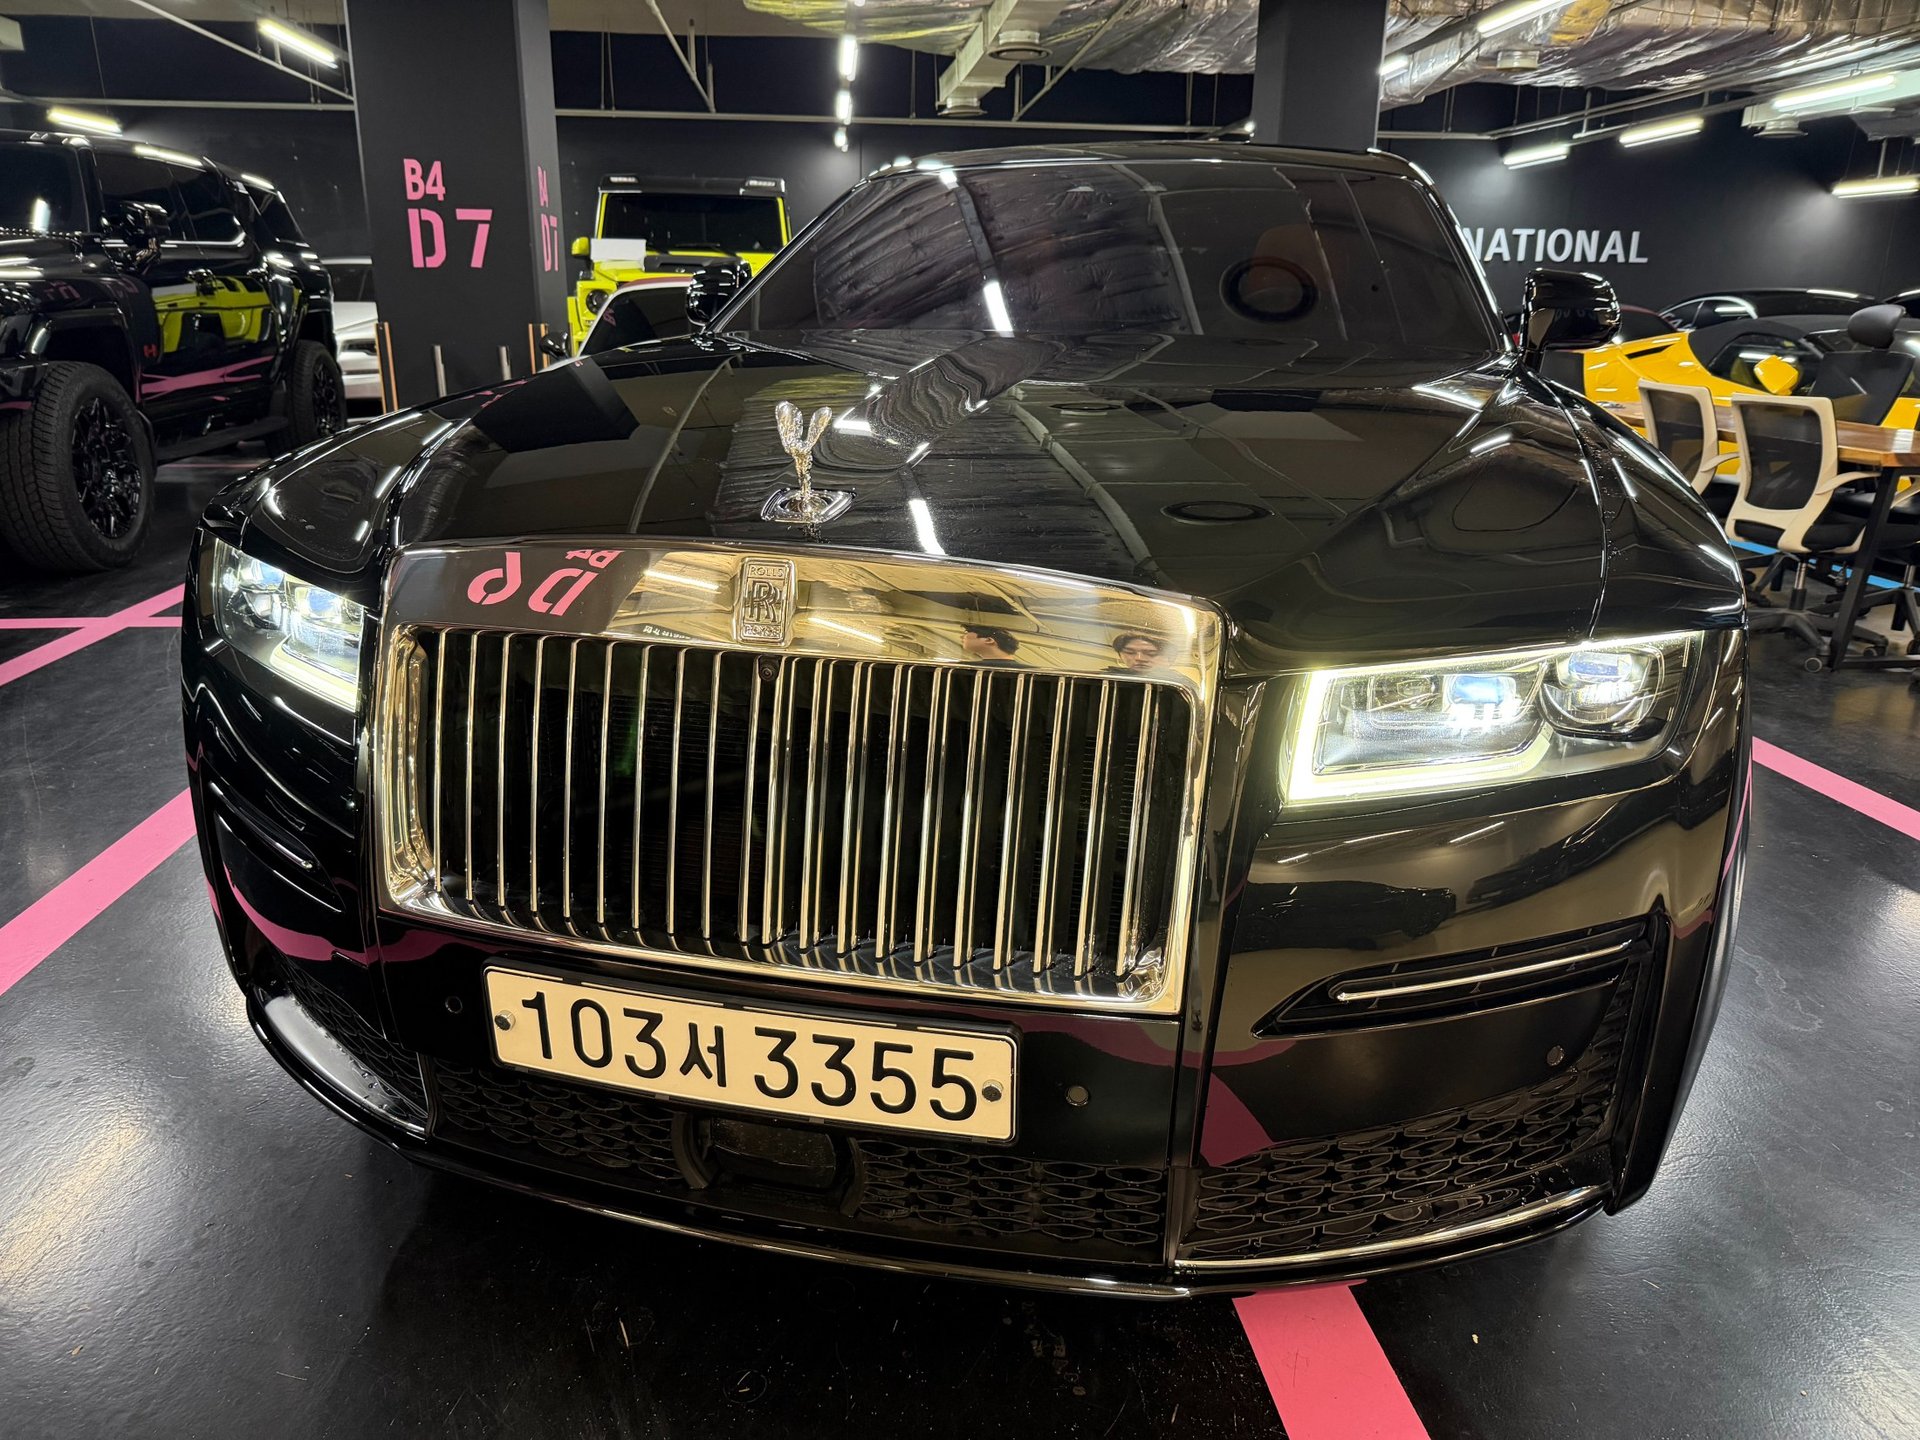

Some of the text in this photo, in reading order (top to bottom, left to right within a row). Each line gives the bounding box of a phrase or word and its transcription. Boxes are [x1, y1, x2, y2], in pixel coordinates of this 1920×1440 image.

[403, 158, 446, 201] B4
[750, 566, 784, 577] ROLLS
[521, 991, 979, 1121] 103서 3355
